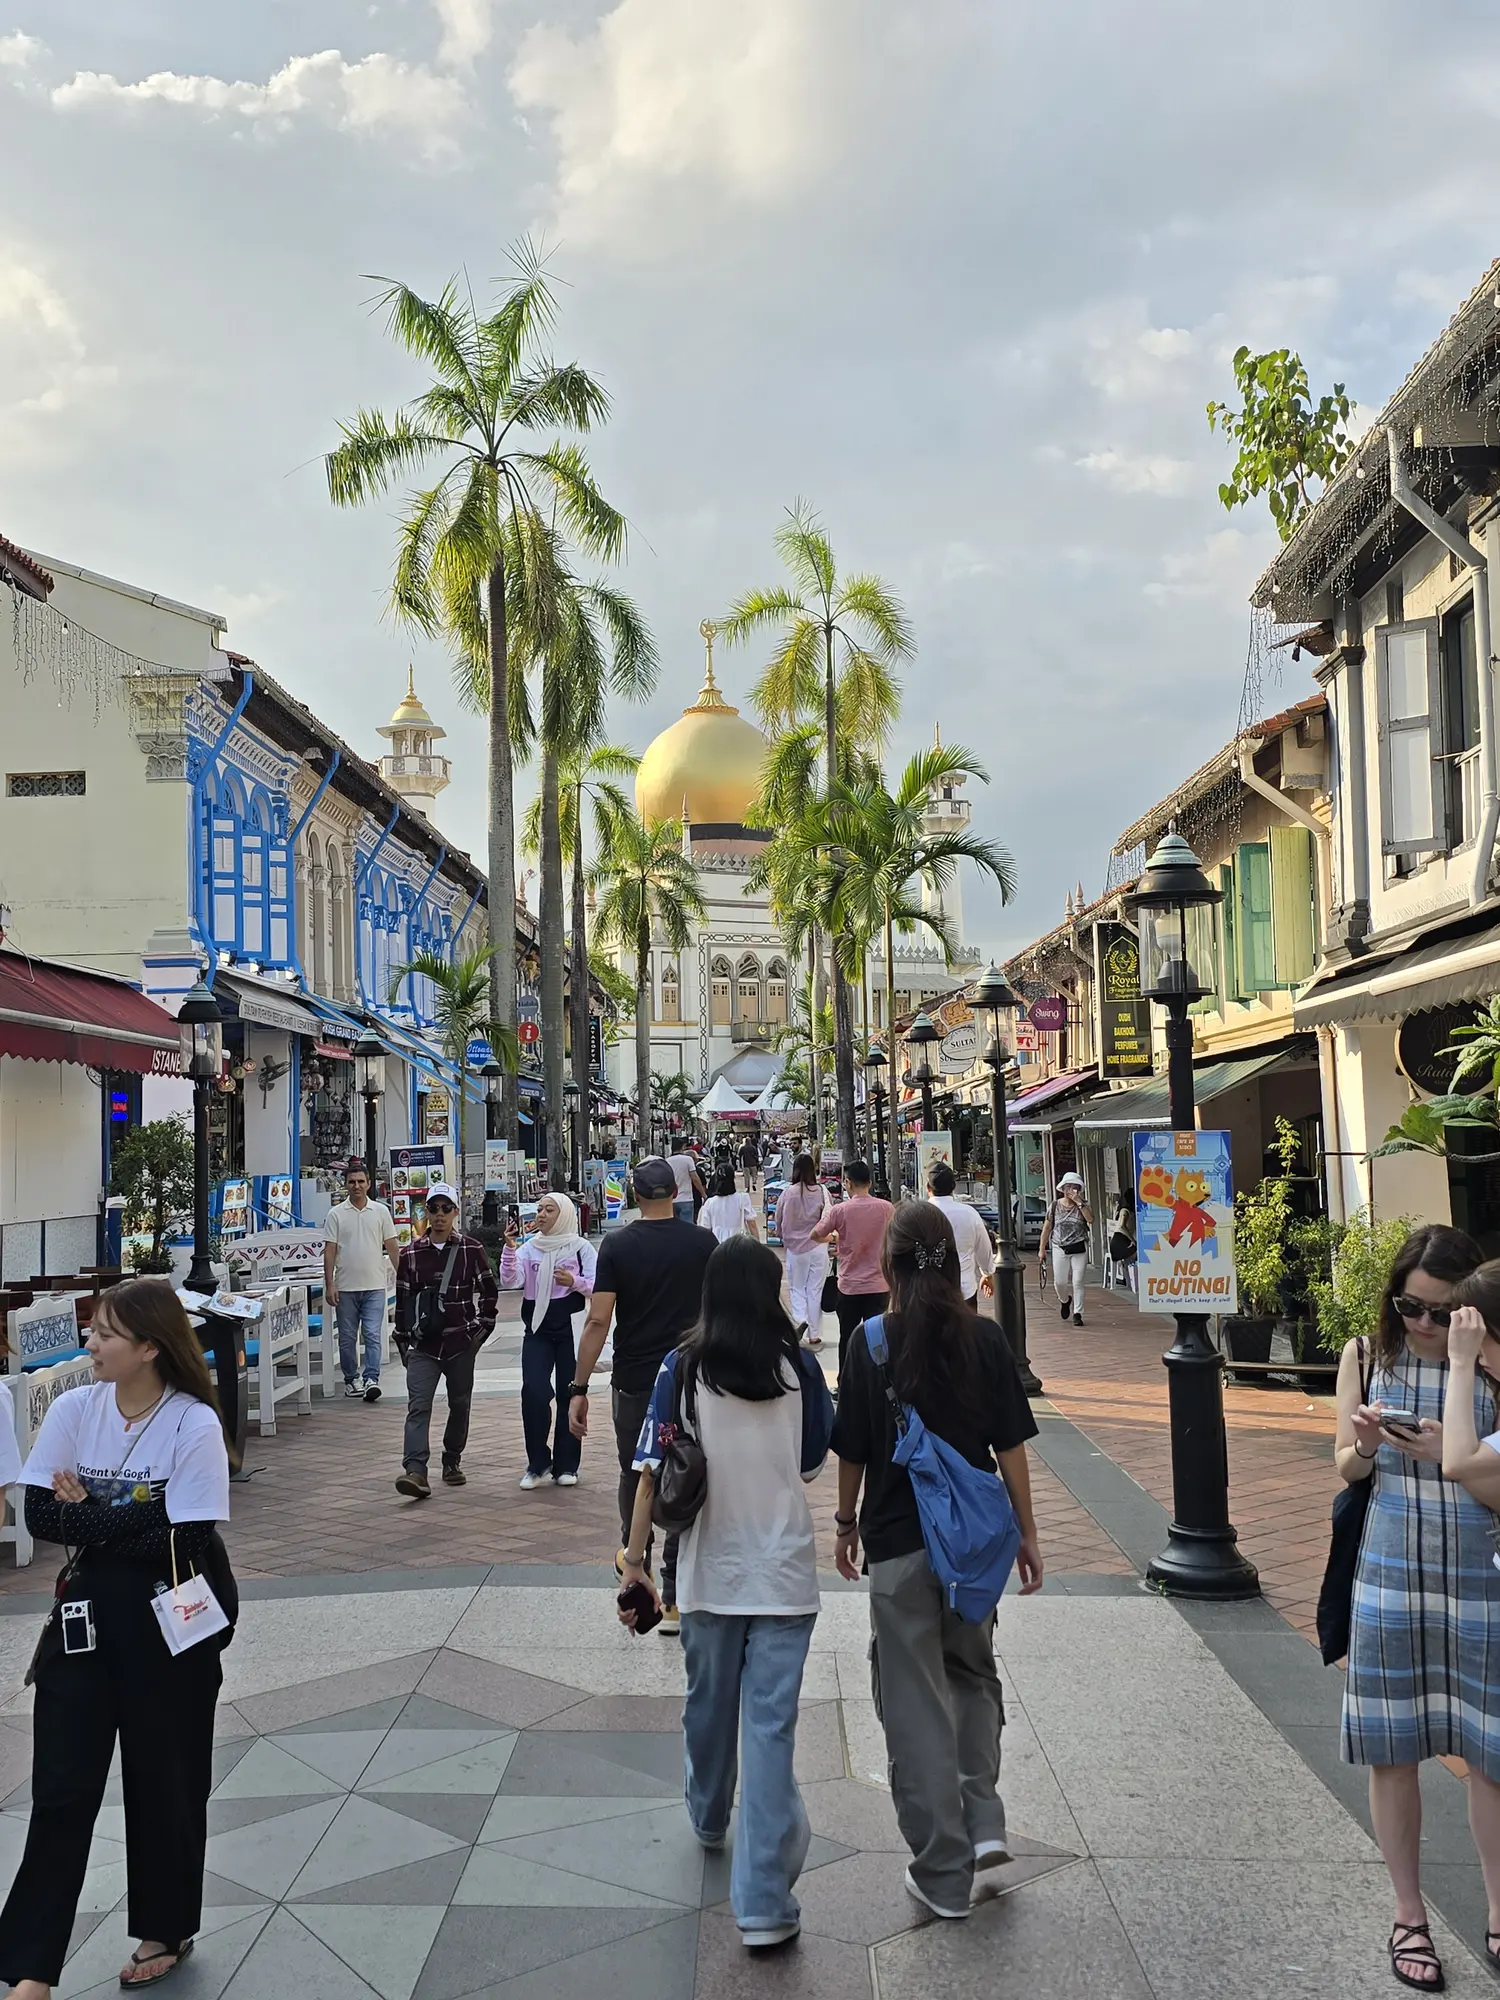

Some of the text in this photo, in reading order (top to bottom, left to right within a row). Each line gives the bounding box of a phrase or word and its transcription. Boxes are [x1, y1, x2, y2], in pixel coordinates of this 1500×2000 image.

[1108, 974, 1140, 988] Royal
[1034, 1008, 1060, 1020] Swing
[1118, 1013, 1131, 1022] OUDH
[1115, 1040, 1138, 1050] PERFUMES
[1107, 1054, 1149, 1064] HOME FRAGRANCES
[1173, 1259, 1202, 1276] NO
[1147, 1276, 1231, 1296] TOUTING!
[77, 1463, 109, 1478] incent
